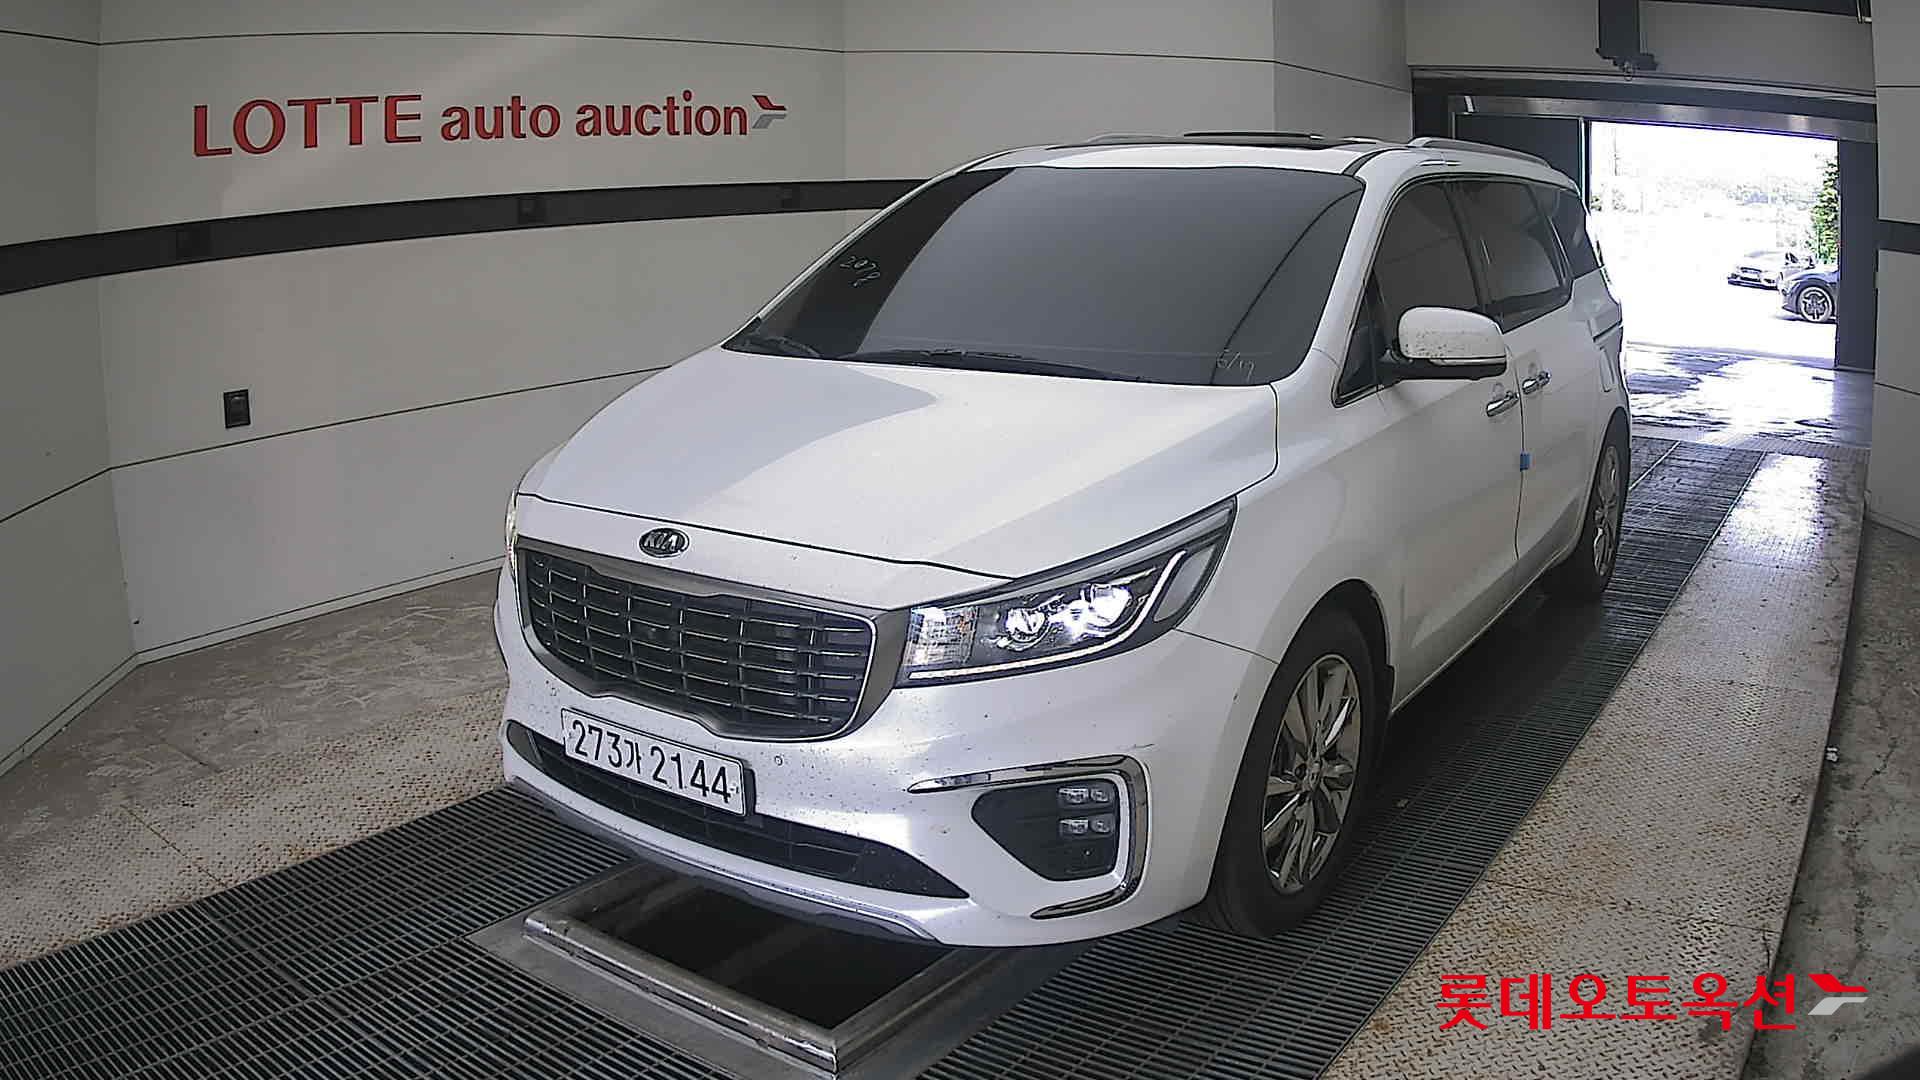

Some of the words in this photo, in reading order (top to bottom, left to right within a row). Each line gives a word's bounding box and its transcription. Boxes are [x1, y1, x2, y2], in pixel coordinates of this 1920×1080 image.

[193, 94, 422, 158] LOTTE
[440, 96, 561, 141] auto
[575, 90, 749, 137] auction
[643, 531, 679, 552] KIA
[572, 719, 642, 775] 273가
[650, 746, 732, 804] 2144
